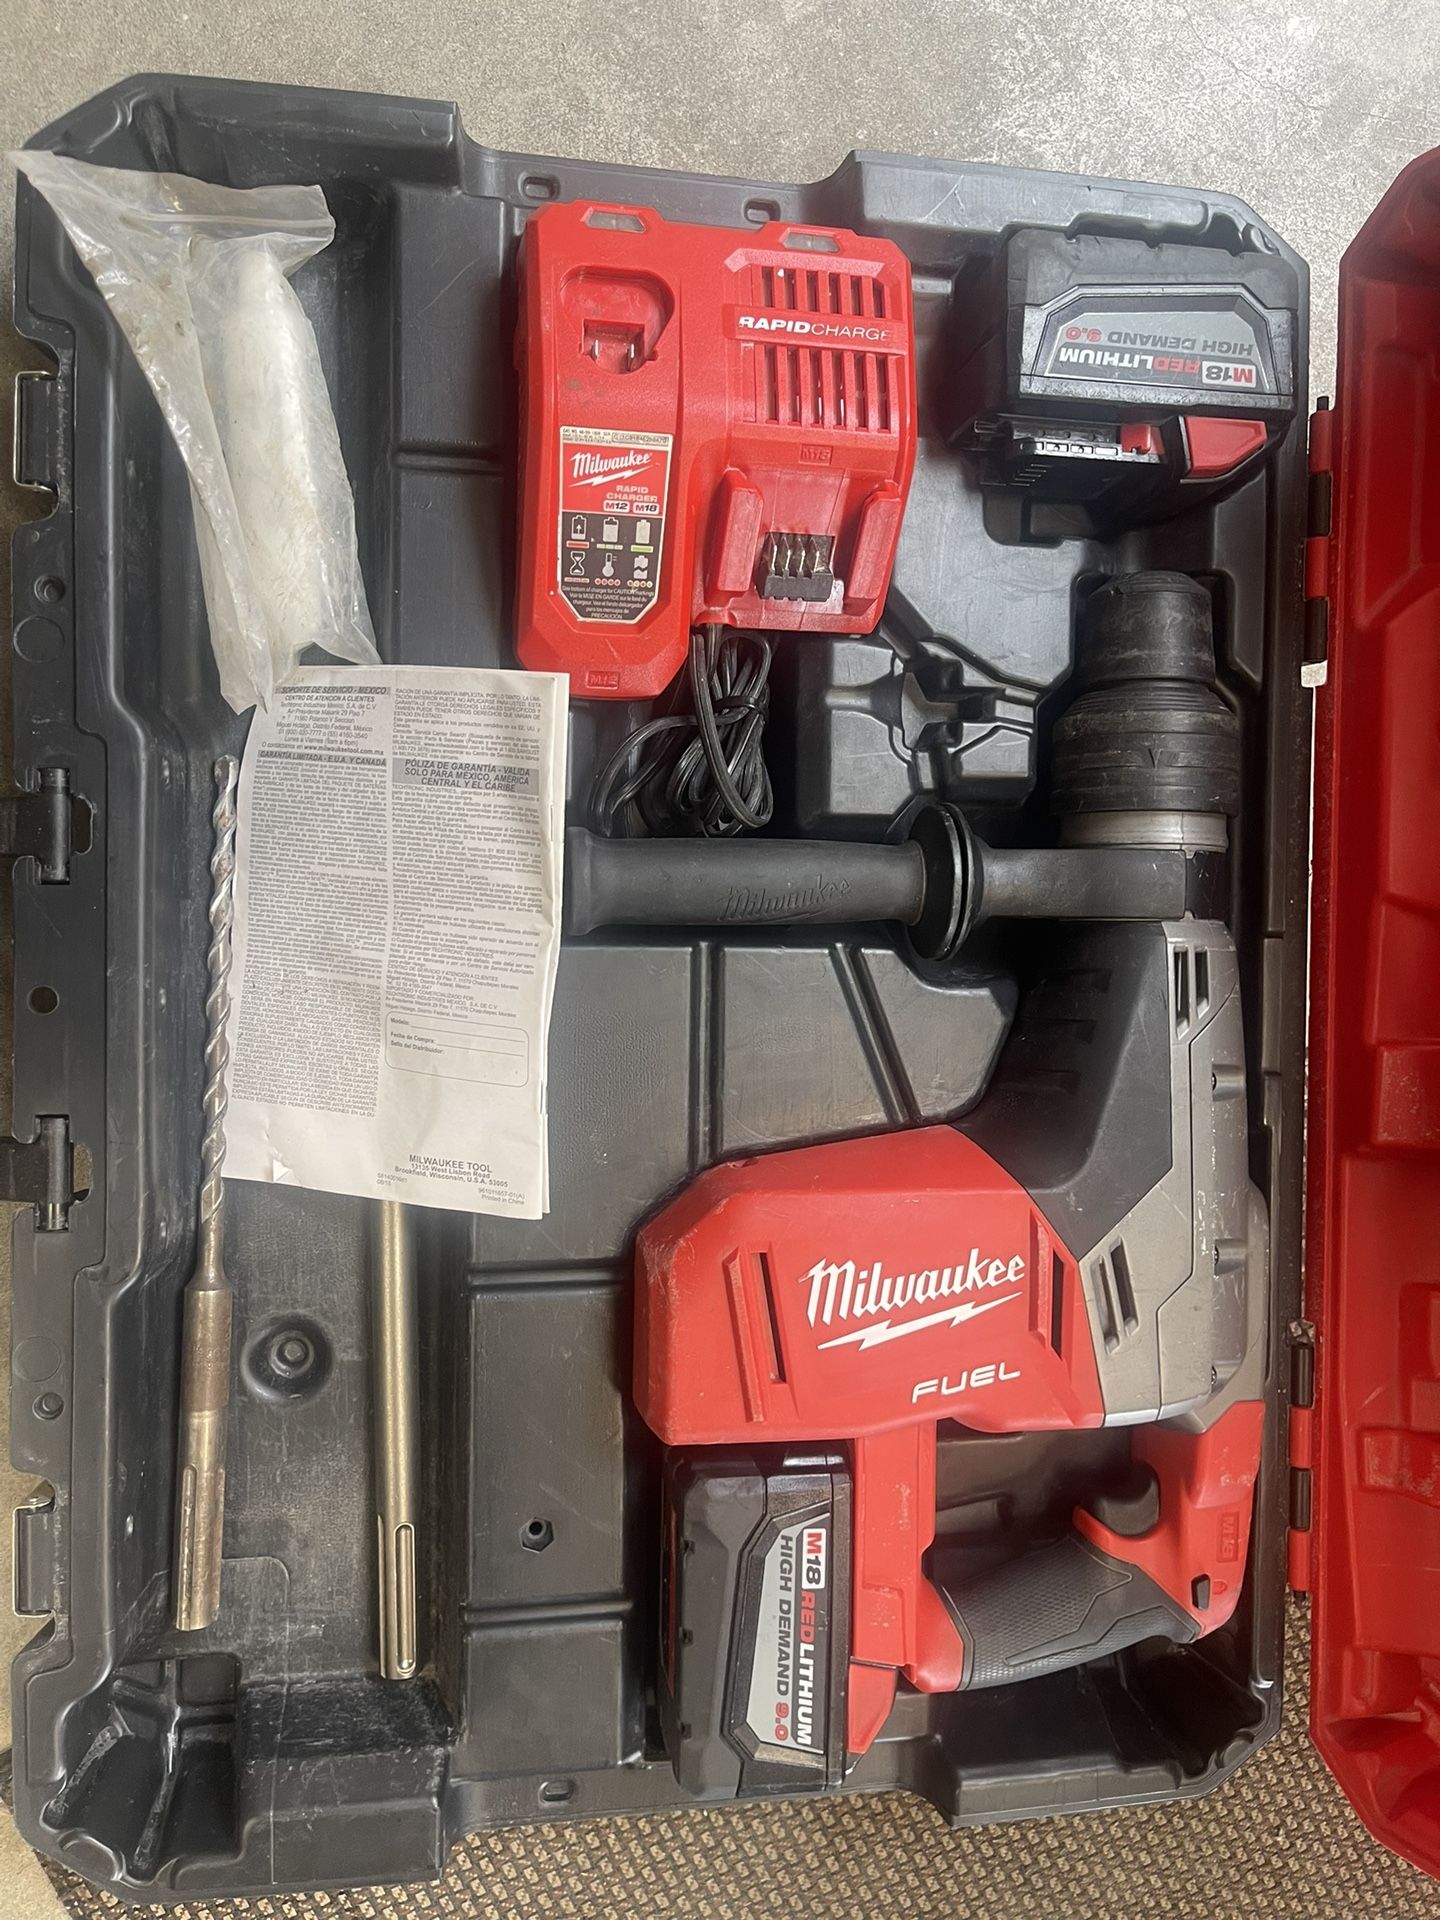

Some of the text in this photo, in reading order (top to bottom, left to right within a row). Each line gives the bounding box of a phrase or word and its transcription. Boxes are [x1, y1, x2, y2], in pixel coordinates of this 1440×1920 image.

[1065, 326, 1254, 356] HIGH DEMAND 9.0
[1059, 347, 1254, 384] M18 REDLITHIUM
[569, 450, 651, 479] Milwaukee
[606, 492, 658, 502] CHARGER
[616, 485, 648, 494] RAPID
[605, 502, 658, 512] M12 M18
[292, 752, 324, 760] LIMITADA
[405, 758, 435, 769] PÓLIZA
[437, 762, 449, 770] DE
[451, 762, 496, 773] GARANTÍA
[404, 768, 428, 776] SOLO
[430, 769, 453, 778] PARA
[420, 778, 461, 788] CENTRAL
[472, 781, 482, 789] EL
[485, 782, 516, 793] CARIBE
[722, 873, 850, 921] Milwaukee
[408, 1154, 493, 1173] MILWAUKEE TOOL
[431, 1166, 447, 1174] West
[449, 1168, 471, 1178] Lisbon
[395, 1165, 428, 1178] Brookfield,
[430, 1171, 465, 1183] Wisconsin,
[467, 1176, 487, 1185] U.S.A.
[489, 1179, 508, 1188] 53005
[481, 1194, 501, 1202] Printed
[798, 1248, 1025, 1328] Milwaukee
[912, 1362, 1020, 1404] FUEL
[774, 1534, 793, 1741] HIGH DEMAND 9.0
[798, 1532, 822, 1745] M18 REDLITHIUM
